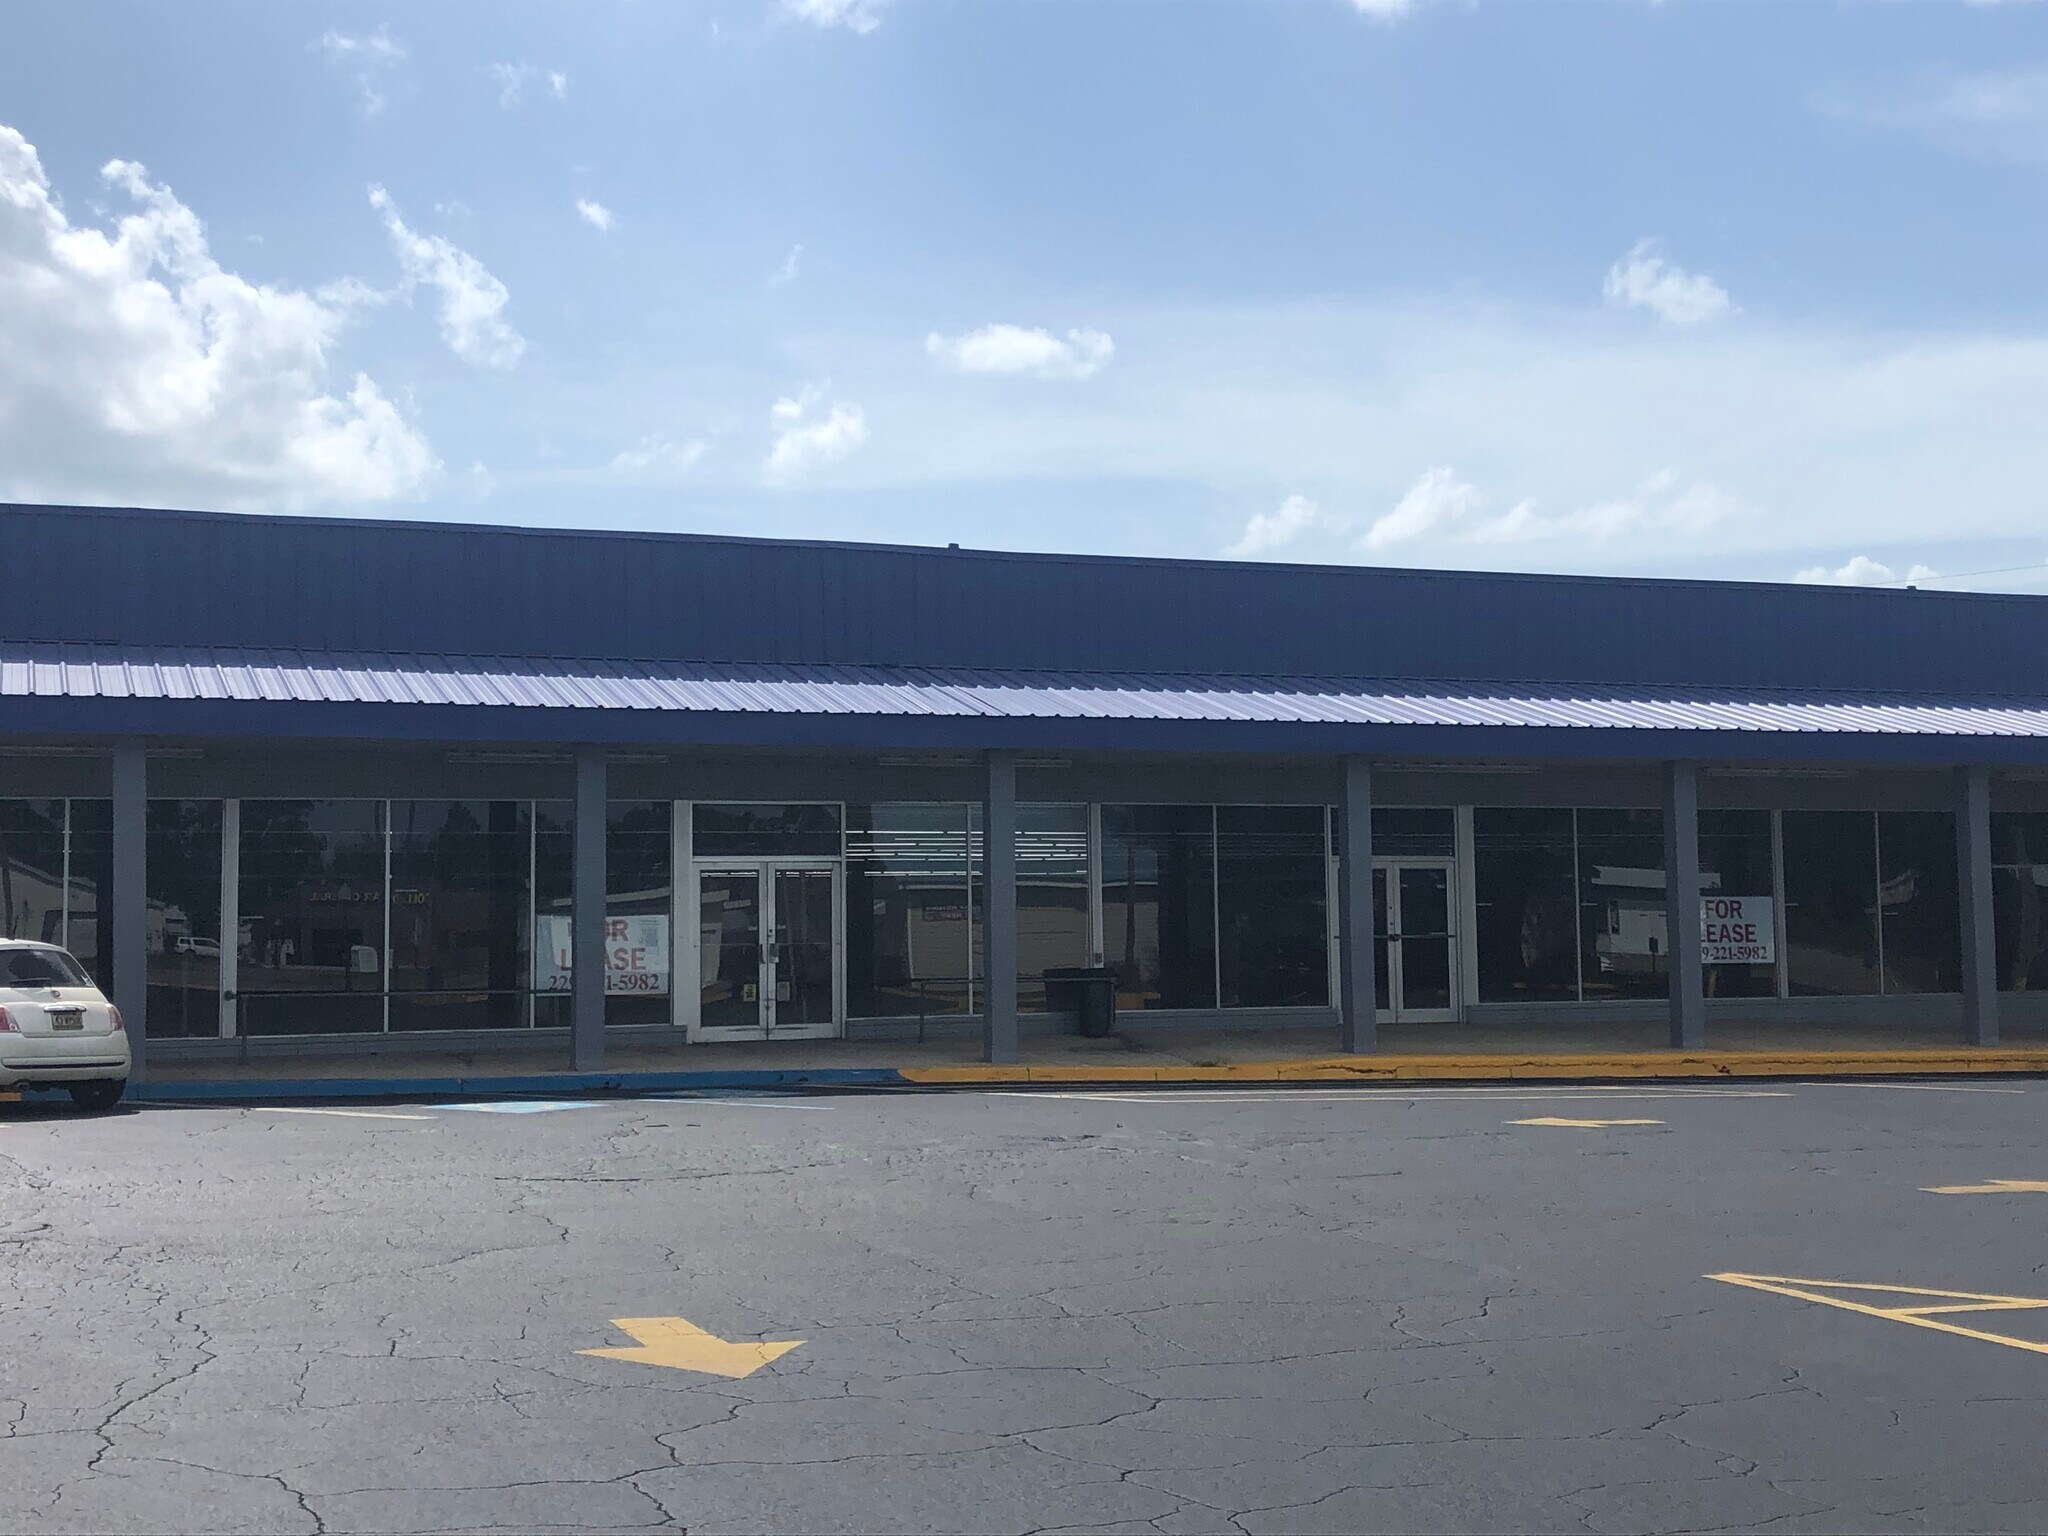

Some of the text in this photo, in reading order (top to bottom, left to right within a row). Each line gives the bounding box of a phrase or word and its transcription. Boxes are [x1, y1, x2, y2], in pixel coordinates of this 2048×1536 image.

[1705, 900, 1743, 919] FOR
[1701, 923, 1757, 943] EASE
[1702, 946, 1768, 960] 9-221-5982
[549, 974, 660, 992] 221-5982
